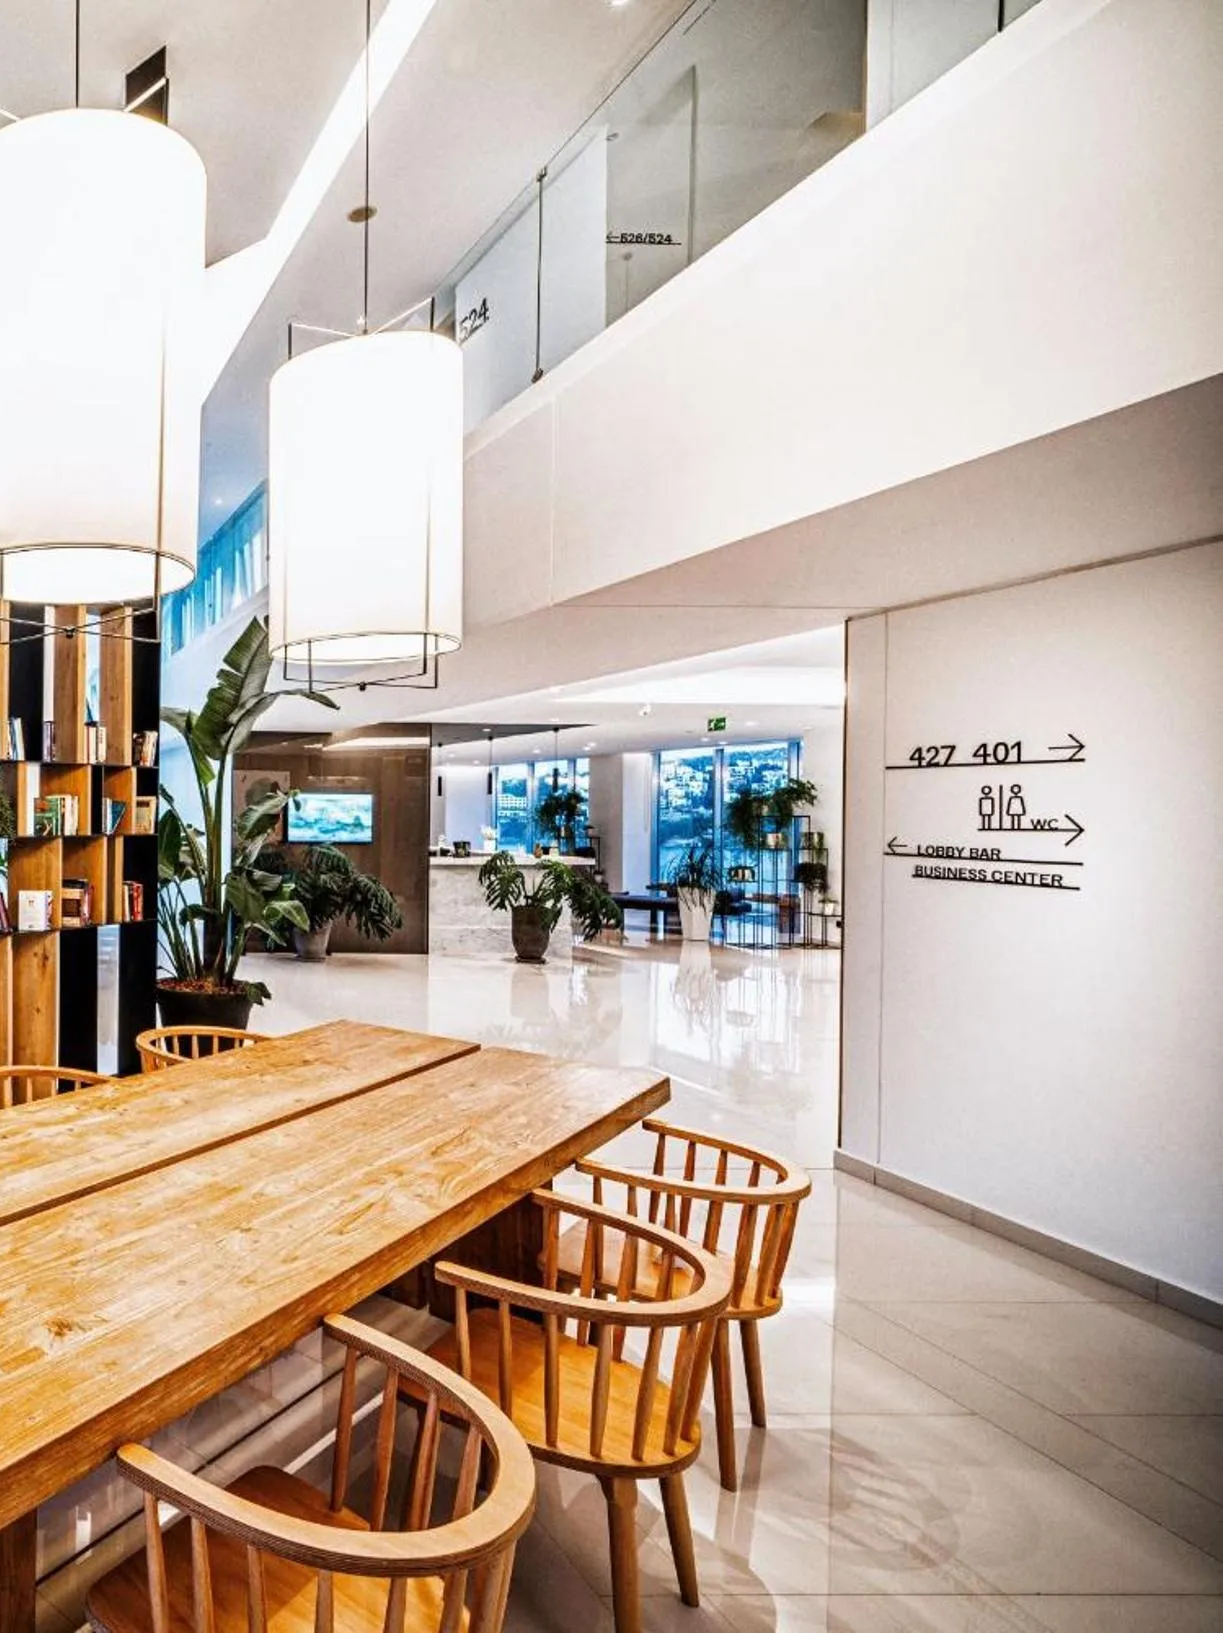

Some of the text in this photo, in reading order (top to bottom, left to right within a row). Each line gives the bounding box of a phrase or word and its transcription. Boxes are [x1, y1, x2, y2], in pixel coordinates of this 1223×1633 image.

[459, 297, 489, 341] 524
[909, 740, 1023, 767] 427 401
[1030, 818, 1060, 830] WC
[916, 844, 1002, 861] LOBBY BAR
[914, 864, 1064, 887] BUSINESS CENTER
